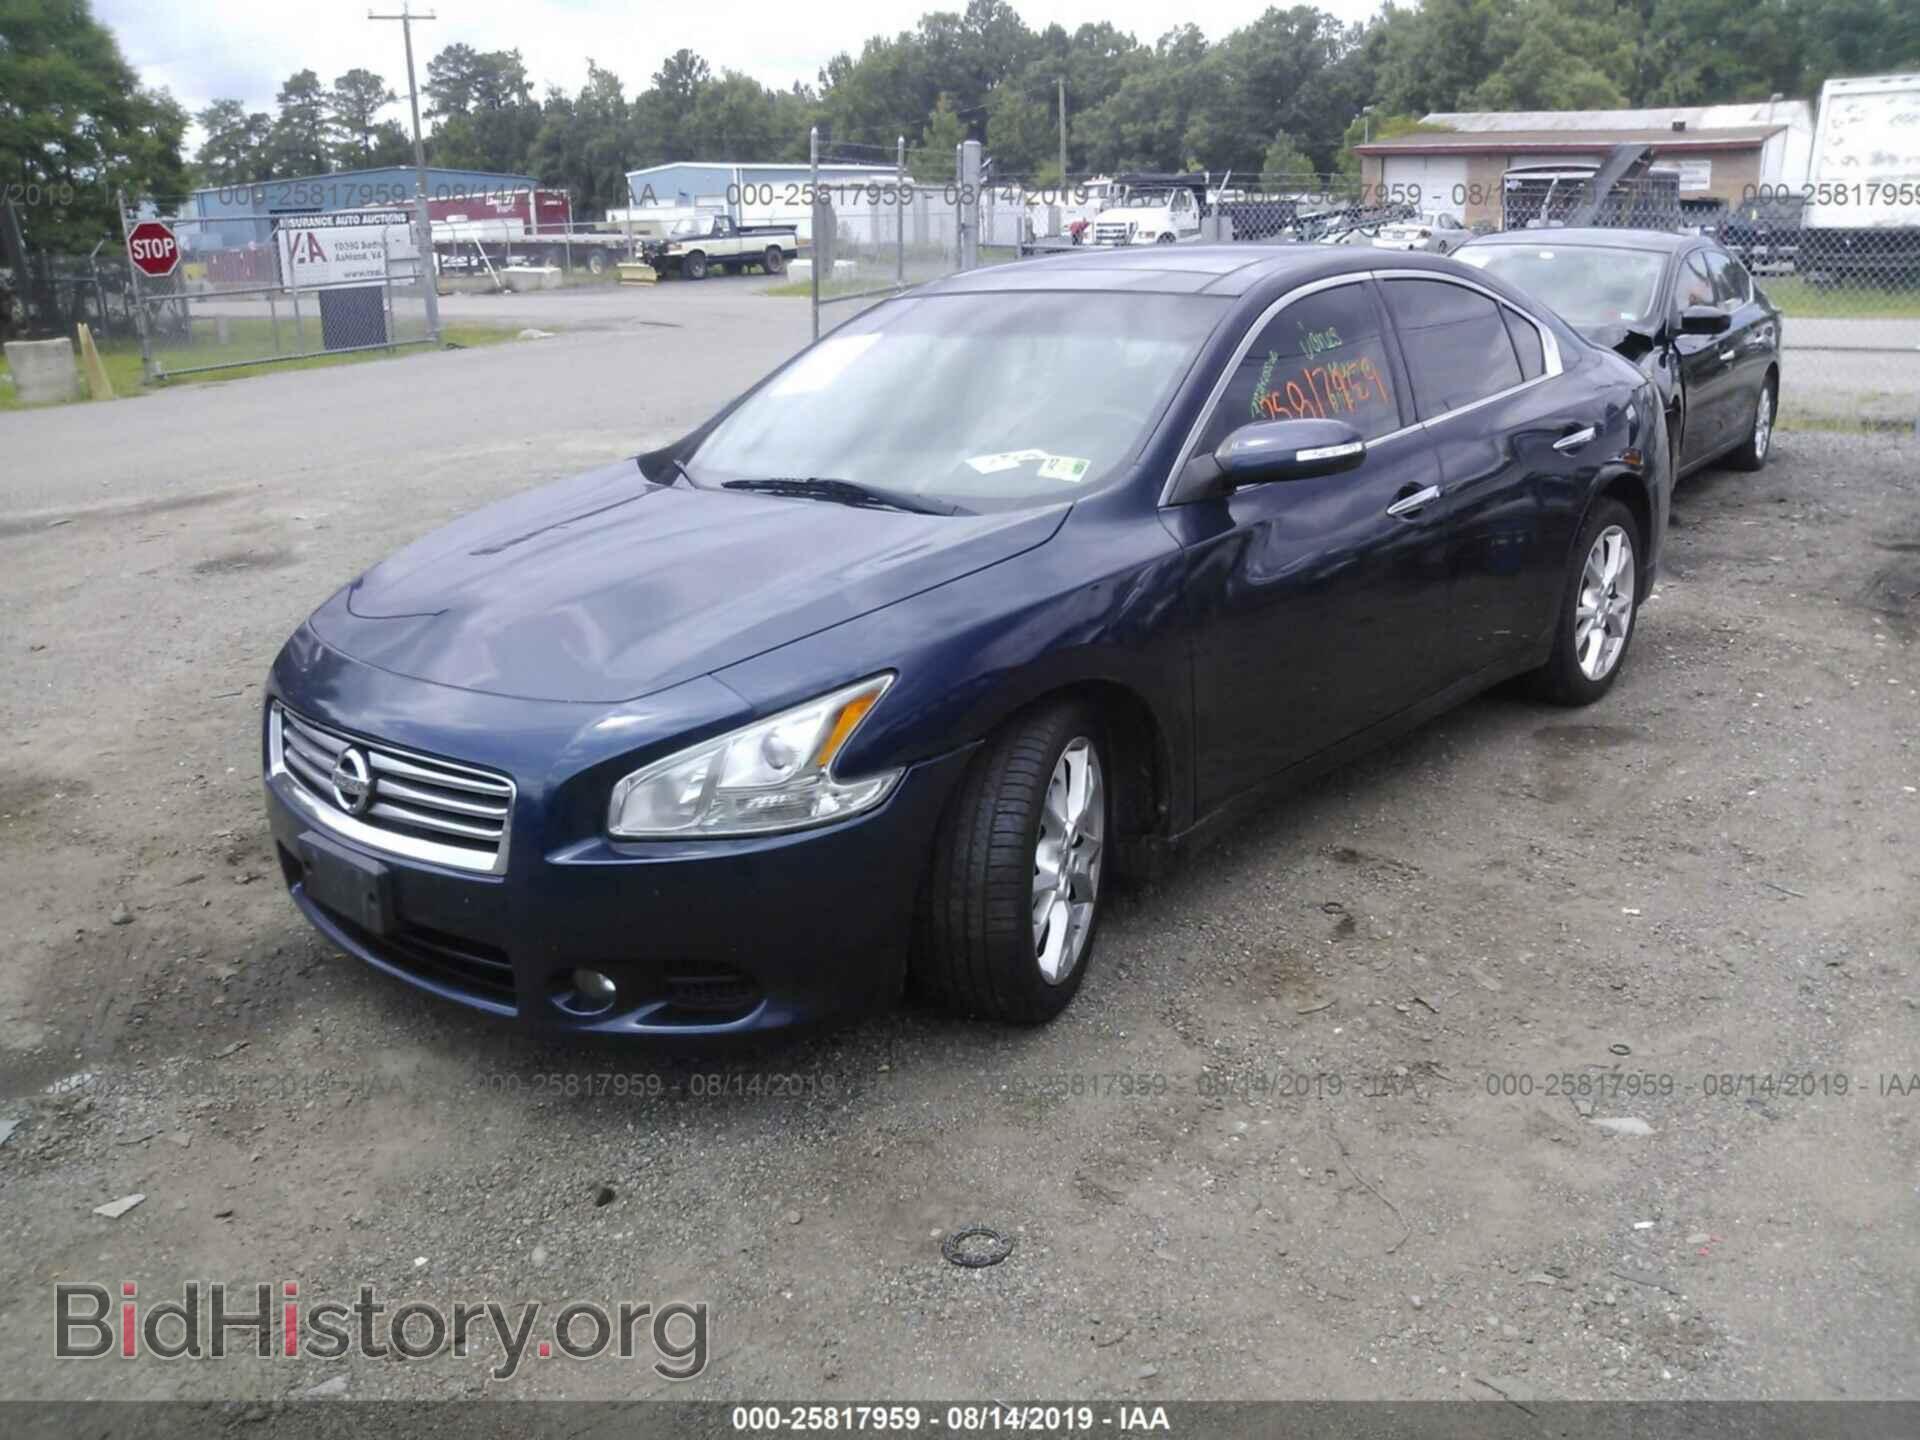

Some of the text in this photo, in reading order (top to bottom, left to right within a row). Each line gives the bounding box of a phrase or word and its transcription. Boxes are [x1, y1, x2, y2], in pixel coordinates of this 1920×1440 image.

[279, 214, 335, 229] ISURANCE
[336, 213, 361, 226] AUTO
[132, 237, 174, 260] STOP
